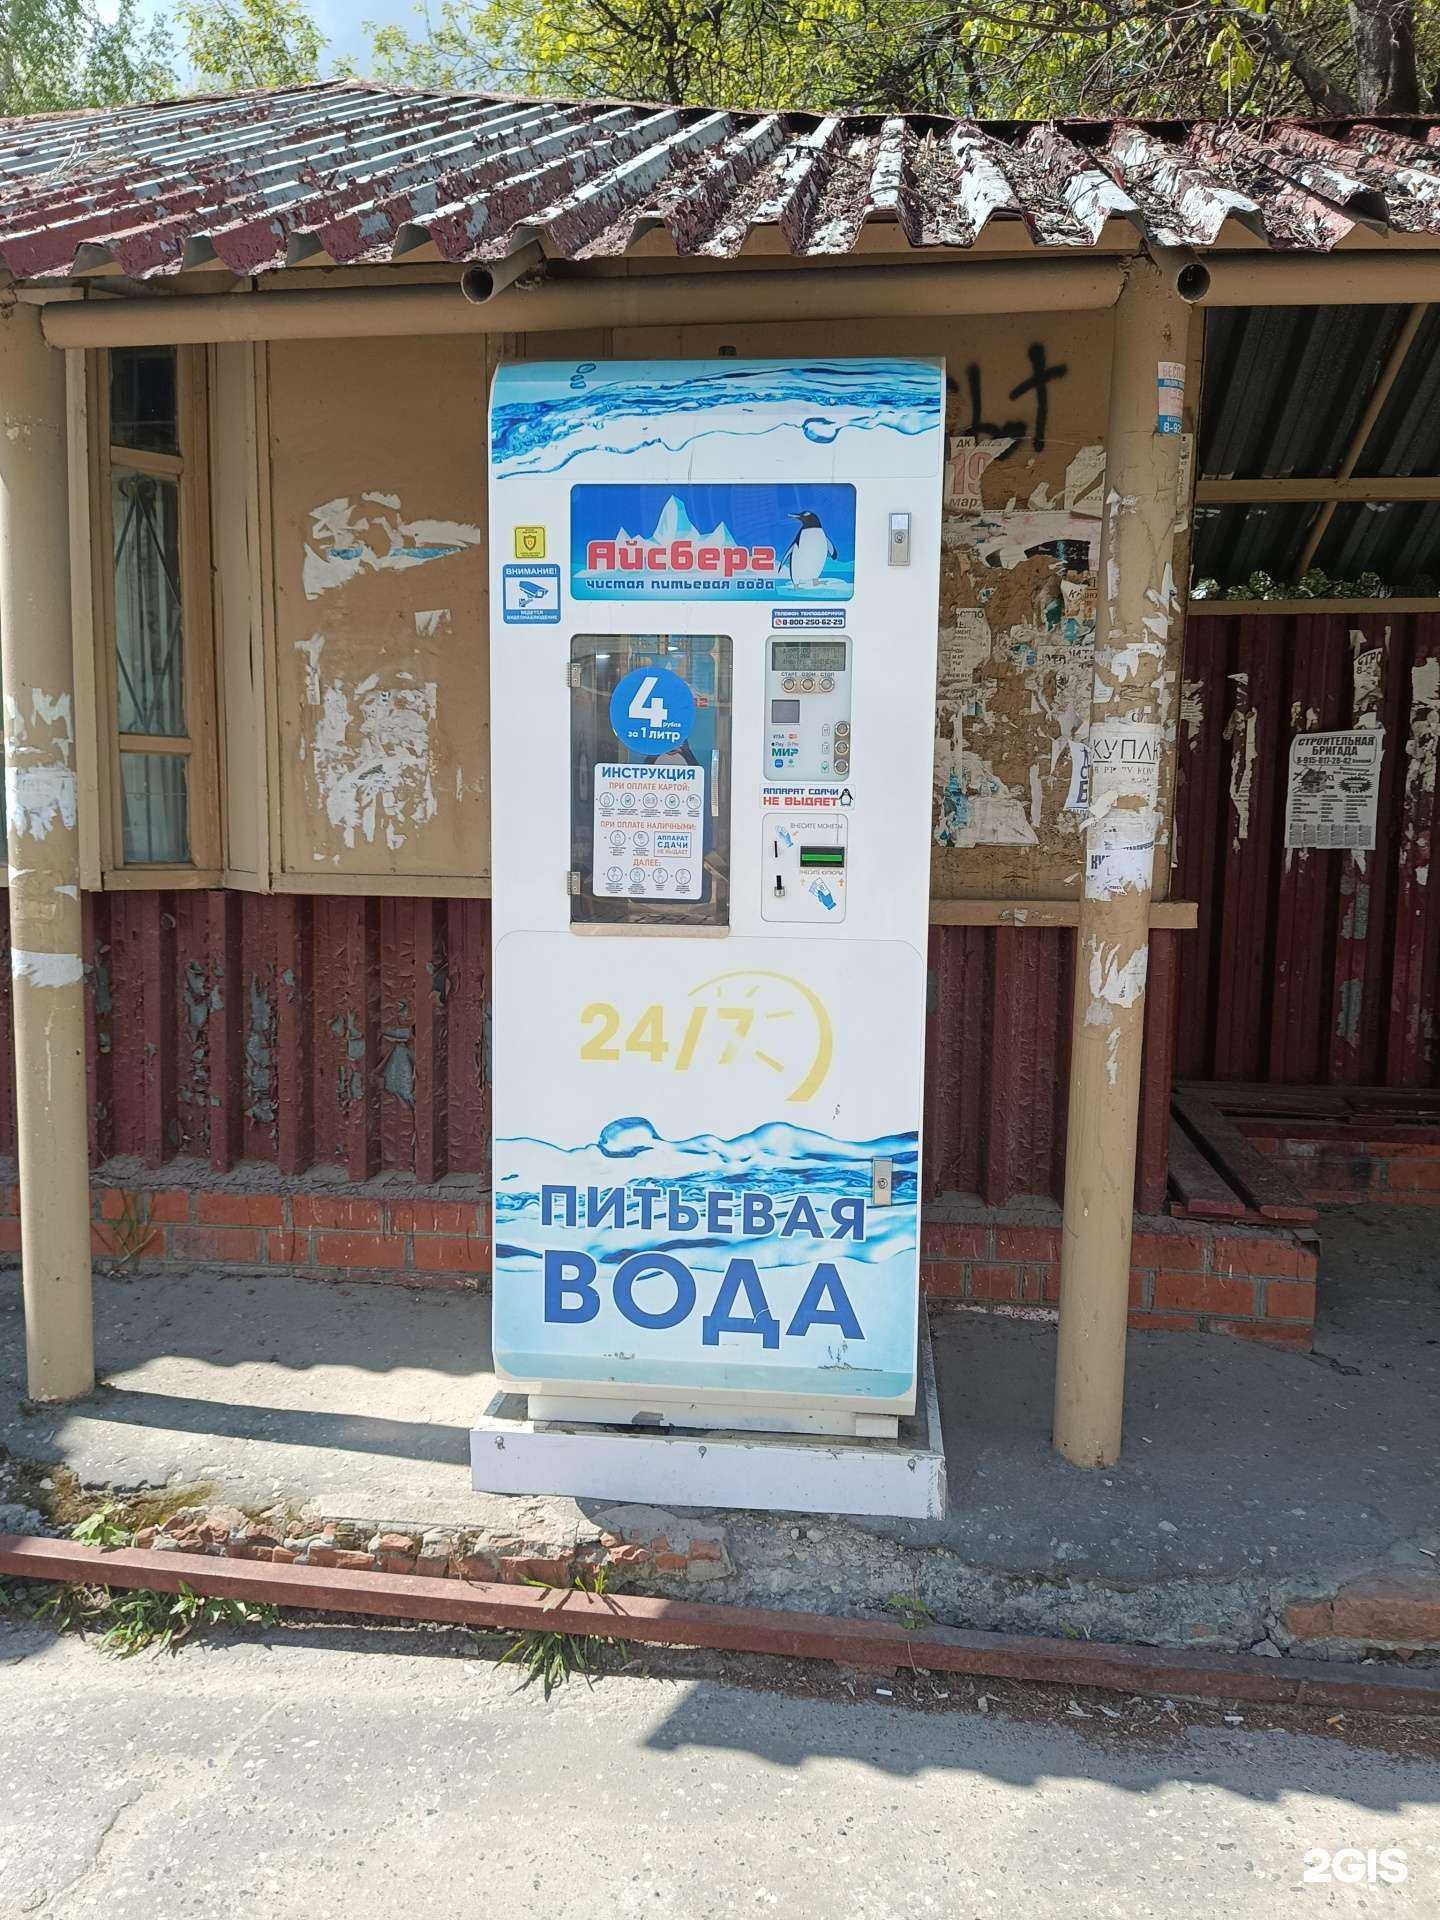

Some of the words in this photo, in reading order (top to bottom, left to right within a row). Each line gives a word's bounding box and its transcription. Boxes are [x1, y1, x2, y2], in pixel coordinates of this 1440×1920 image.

[587, 541, 775, 577] Айсберг
[506, 567, 557, 575] ВНИМАНИЕ!
[587, 579, 645, 590] чистая
[651, 579, 730, 590] питьевая
[737, 578, 775, 590] вода
[628, 677, 668, 728] 4
[627, 730, 639, 738] за
[640, 727, 647, 738] 1
[649, 730, 681, 742] литр
[1298, 736, 1374, 746] СТРОИТЕЛЬНАЯ
[771, 748, 799, 757] МИР
[1312, 746, 1358, 757] БРИГАДА
[601, 766, 696, 781] ИНСТРУКЦИЯ
[627, 782, 656, 791] ОПЛАТЕ
[658, 782, 690, 791] КАРТОЙ:
[763, 787, 805, 795] АППАРАТ
[808, 788, 839, 796] СДАЧИ
[763, 796, 780, 806] НЕ
[784, 796, 839, 806] ВЫДАЕТ
[617, 821, 645, 829] ОПЛАТЕ
[657, 841, 688, 849] СДАЧИ
[632, 859, 661, 867] ДАЛЕЕ:
[580, 1002, 755, 1071] 24/7
[540, 1184, 866, 1242] ПИТЬЕВАЯ
[543, 1249, 867, 1350] ВОДА
